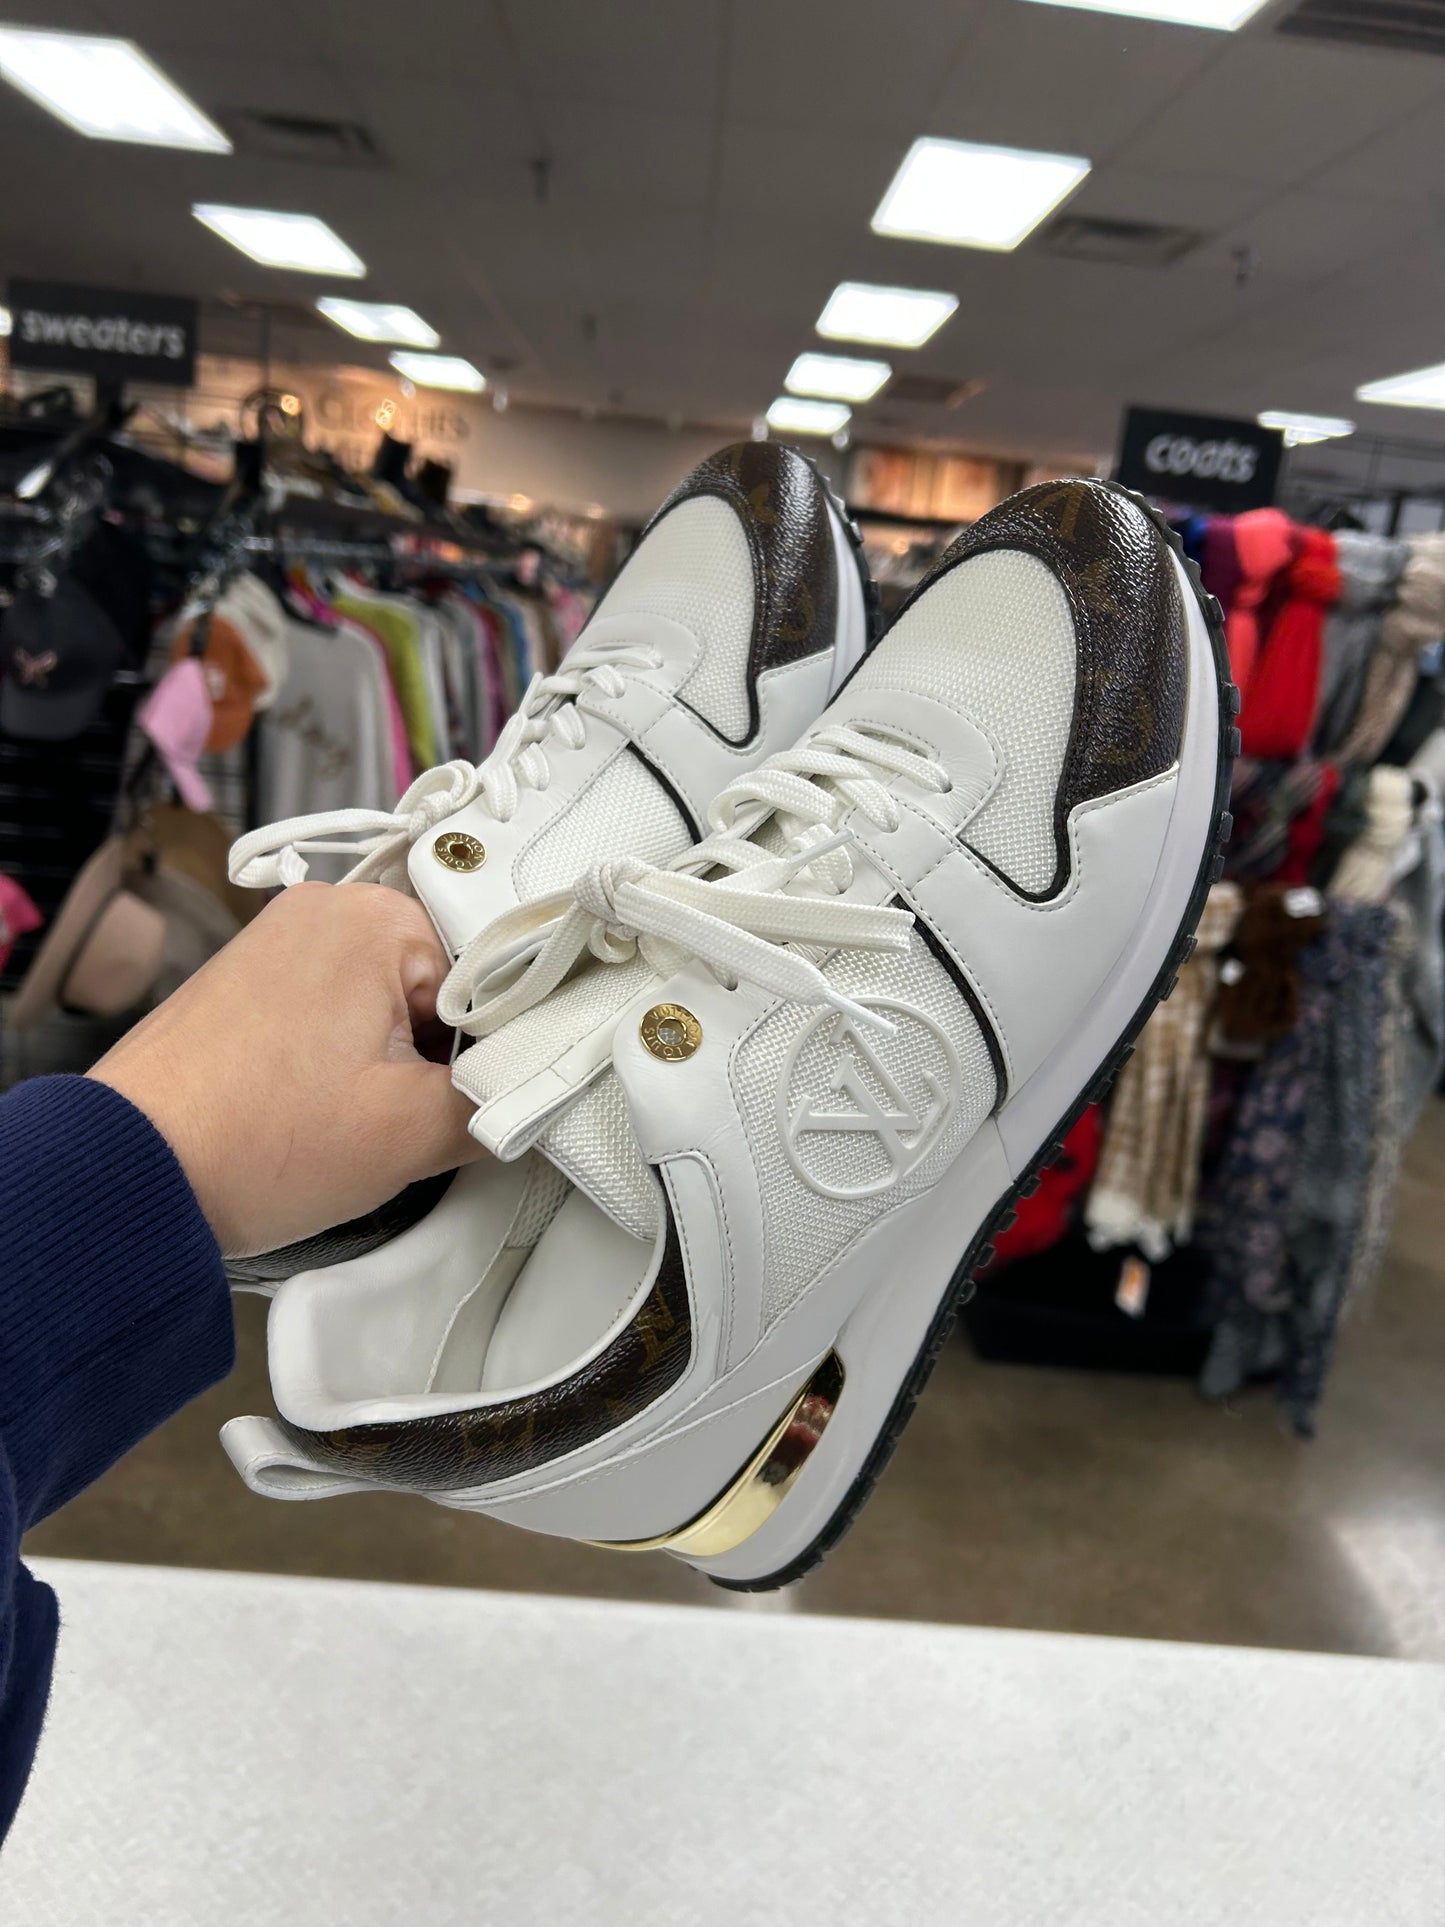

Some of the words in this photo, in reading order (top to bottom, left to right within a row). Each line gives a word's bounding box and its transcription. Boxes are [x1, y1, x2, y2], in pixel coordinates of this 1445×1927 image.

[22, 310, 184, 359] sweaters
[1145, 434, 1257, 482] coats
[644, 1027, 683, 1056] LOUIS
